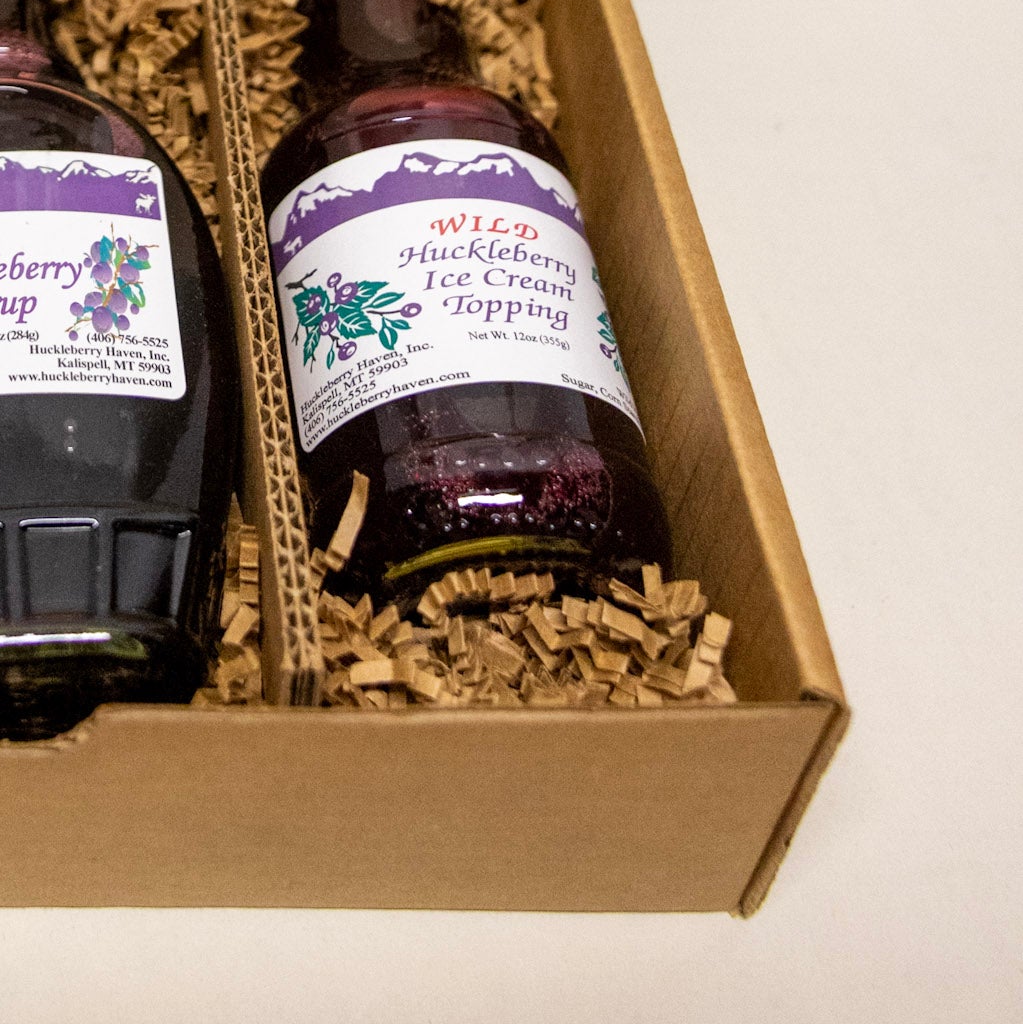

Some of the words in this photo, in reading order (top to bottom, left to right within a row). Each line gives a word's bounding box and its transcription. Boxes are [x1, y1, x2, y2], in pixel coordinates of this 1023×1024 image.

[430, 213, 539, 242] WILD
[398, 237, 576, 284] Huckleberry
[423, 269, 473, 292] Ice
[483, 267, 575, 302] Cream
[443, 293, 569, 331] Topping
[6, 330, 39, 343] (284g)
[29, 344, 102, 359] Huckleberry
[105, 347, 150, 361] Haven,
[150, 350, 170, 362] Inc.
[86, 332, 116, 345] (406)
[118, 334, 169, 349] 756-5525
[468, 330, 488, 341] Net
[490, 330, 510, 342] Wt.
[513, 331, 538, 344] 12oz
[539, 334, 570, 351] (355g)
[8, 371, 173, 389] www.huckleberryhaven.com
[57, 357, 111, 372] Kalispell,
[114, 360, 135, 372] MT
[138, 362, 171, 374] 59903
[300, 367, 354, 414] Huckleberry
[357, 349, 403, 372] Haven,
[406, 342, 434, 354] Inc.
[301, 388, 342, 425] Kalispell,
[344, 373, 367, 392] MT
[369, 358, 408, 377] 59903
[560, 373, 598, 394] Sugar,
[600, 387, 622, 406] Corn
[304, 411, 325, 438] (406)
[326, 380, 377, 415] 756-5525
[305, 370, 471, 447] www.huckleberryhaven.com
